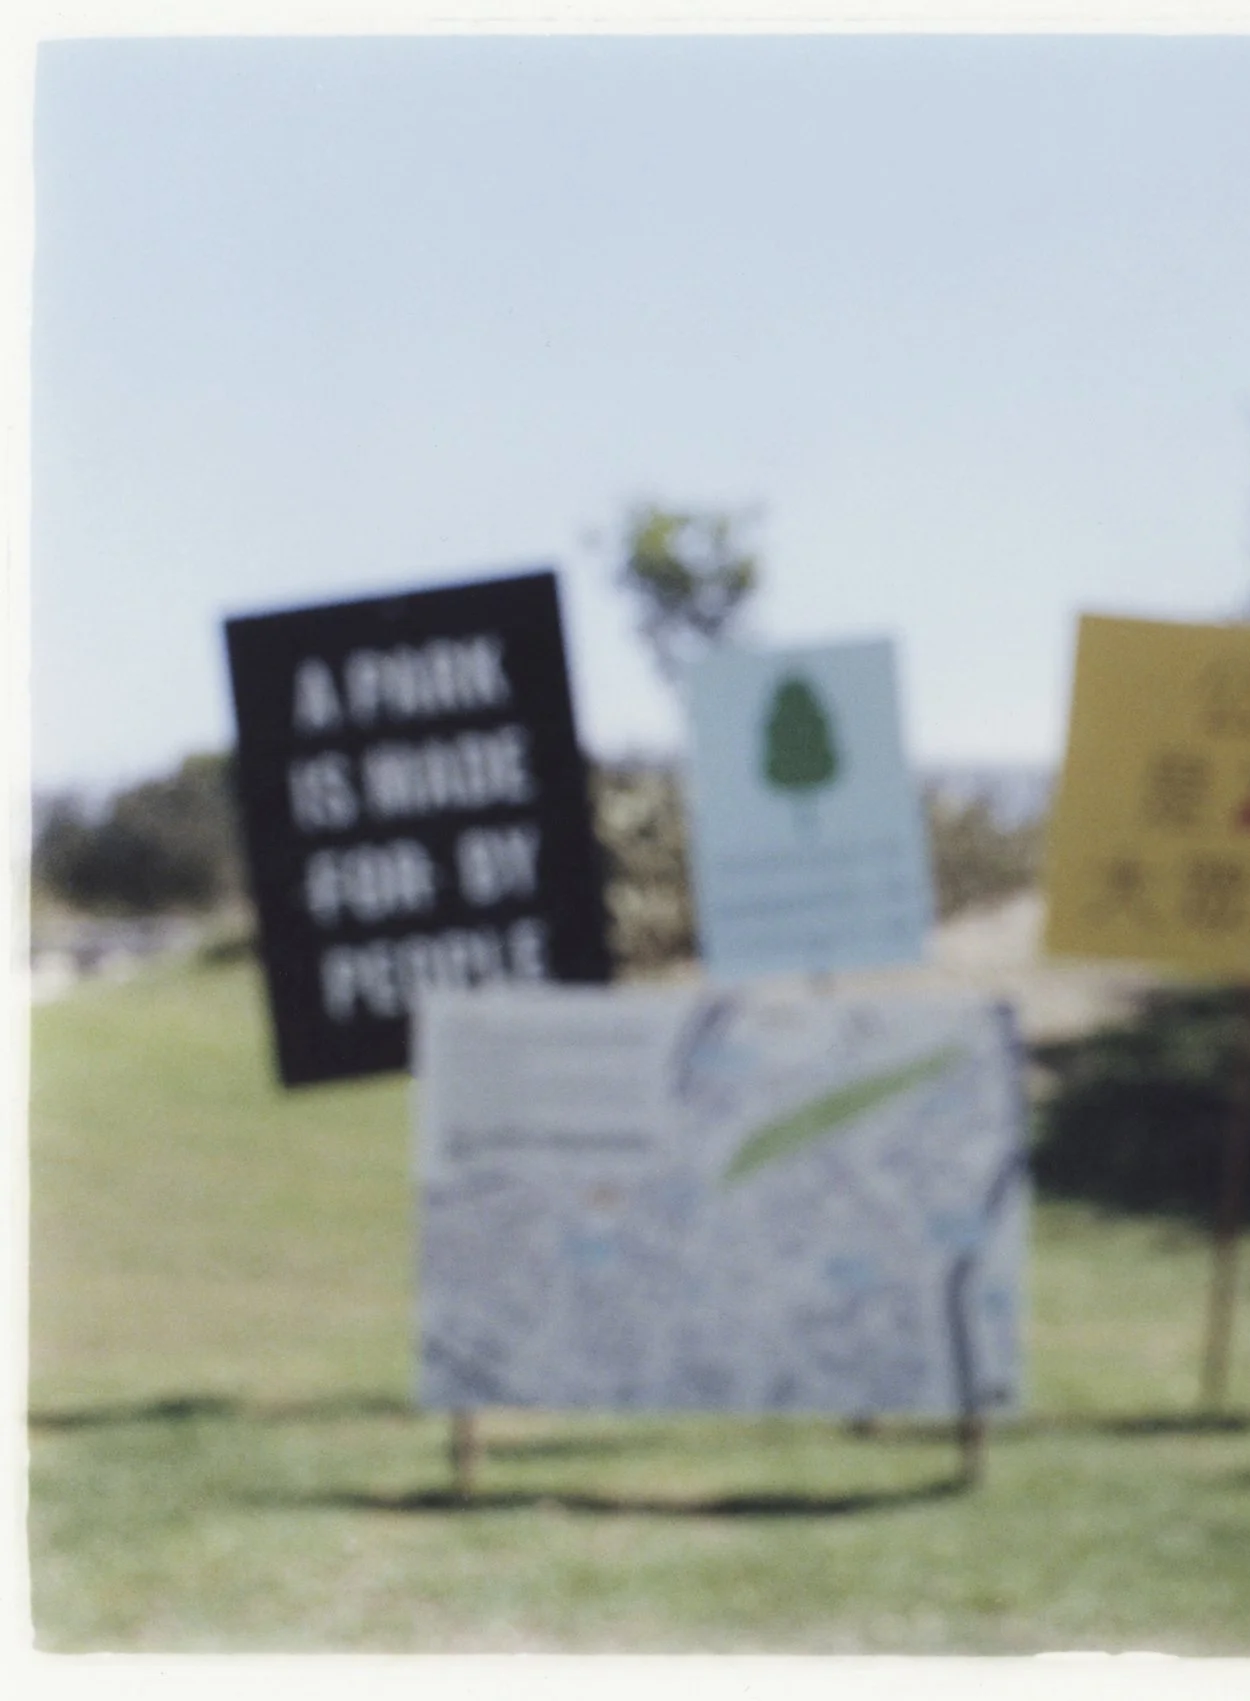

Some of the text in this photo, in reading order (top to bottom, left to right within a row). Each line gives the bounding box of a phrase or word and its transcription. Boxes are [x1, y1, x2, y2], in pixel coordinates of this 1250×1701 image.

[298, 638, 508, 734] A PARK
[294, 731, 533, 831] IS MADE
[309, 827, 535, 920] FOR BY
[324, 923, 549, 1015] PEOPLE
